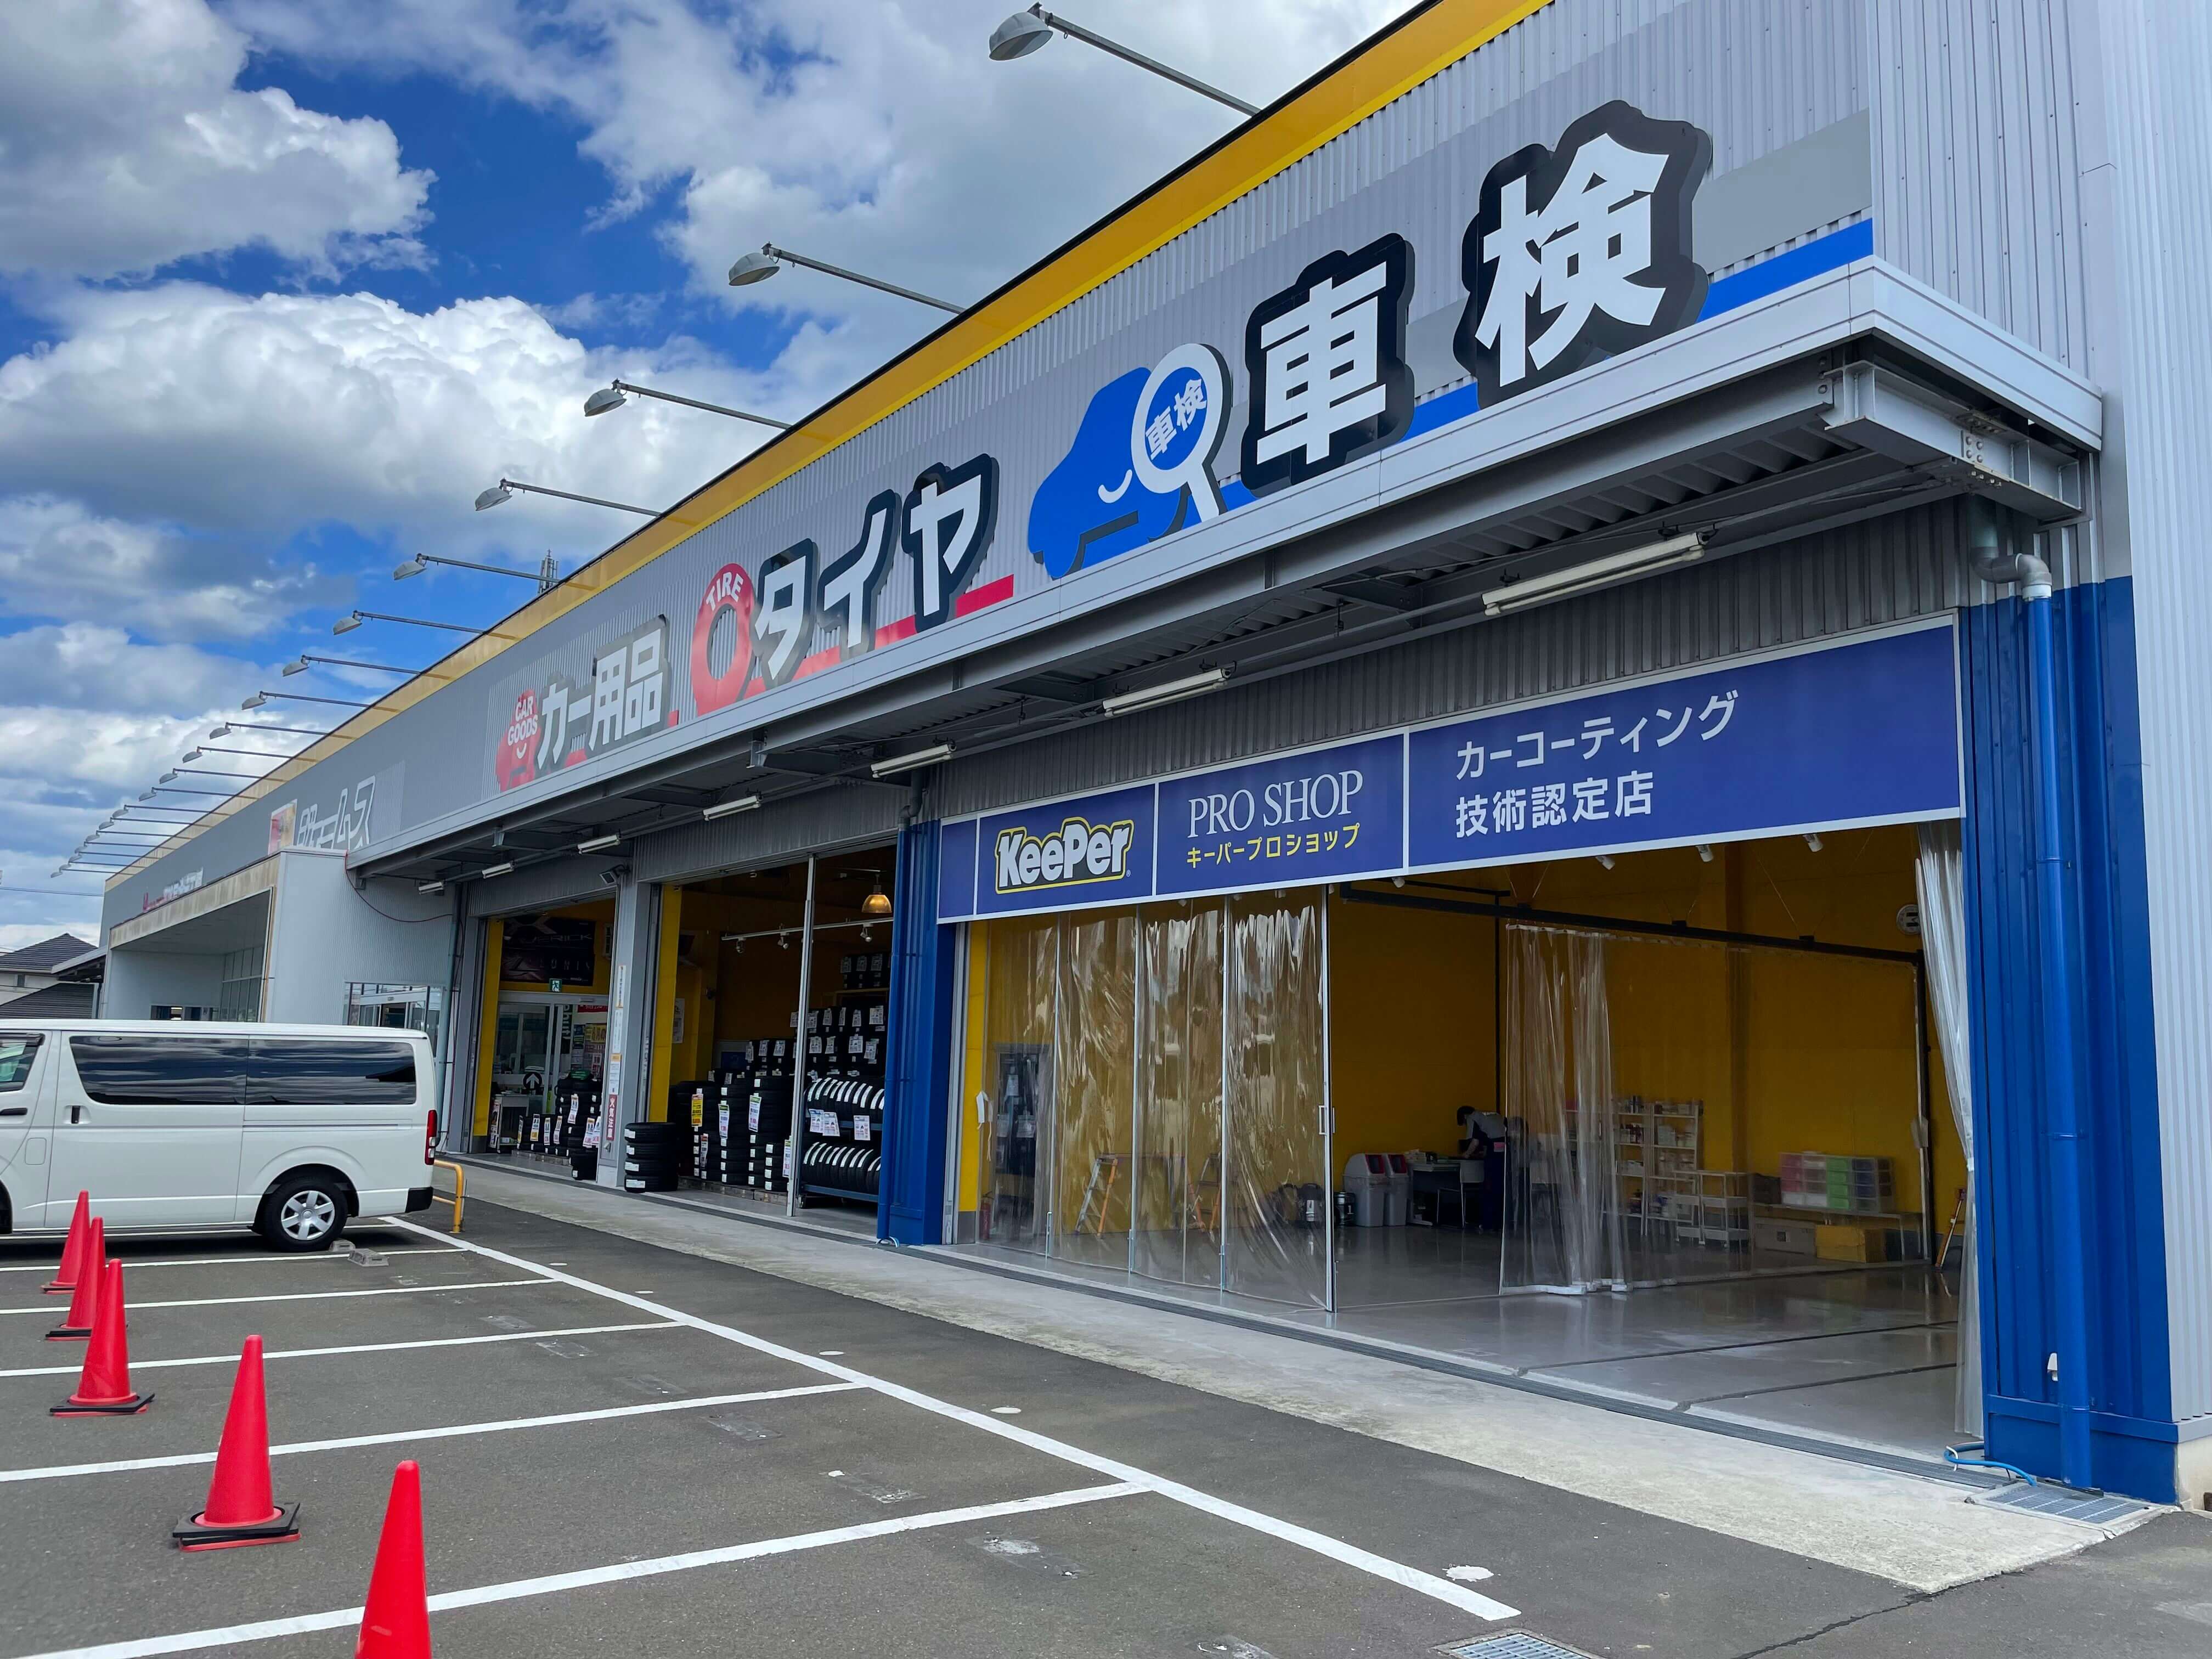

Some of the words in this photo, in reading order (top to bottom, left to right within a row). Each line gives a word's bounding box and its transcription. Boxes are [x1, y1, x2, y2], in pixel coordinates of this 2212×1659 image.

[1255, 132, 1669, 466] 車検
[1145, 378, 1207, 460] 車検
[706, 572, 744, 611] TIRE
[754, 474, 981, 680] タイヤ
[507, 714, 538, 746] GOODS
[515, 696, 534, 721] CAR
[537, 628, 663, 770] カー用品
[1455, 689, 1739, 781] カーコーティング
[1187, 789, 1255, 838] PRO
[1263, 770, 1363, 827] SHOP
[1455, 770, 1654, 839] 技術認定店
[998, 823, 1130, 888] KeePer
[1187, 822, 1360, 869] キーパープロショップ
